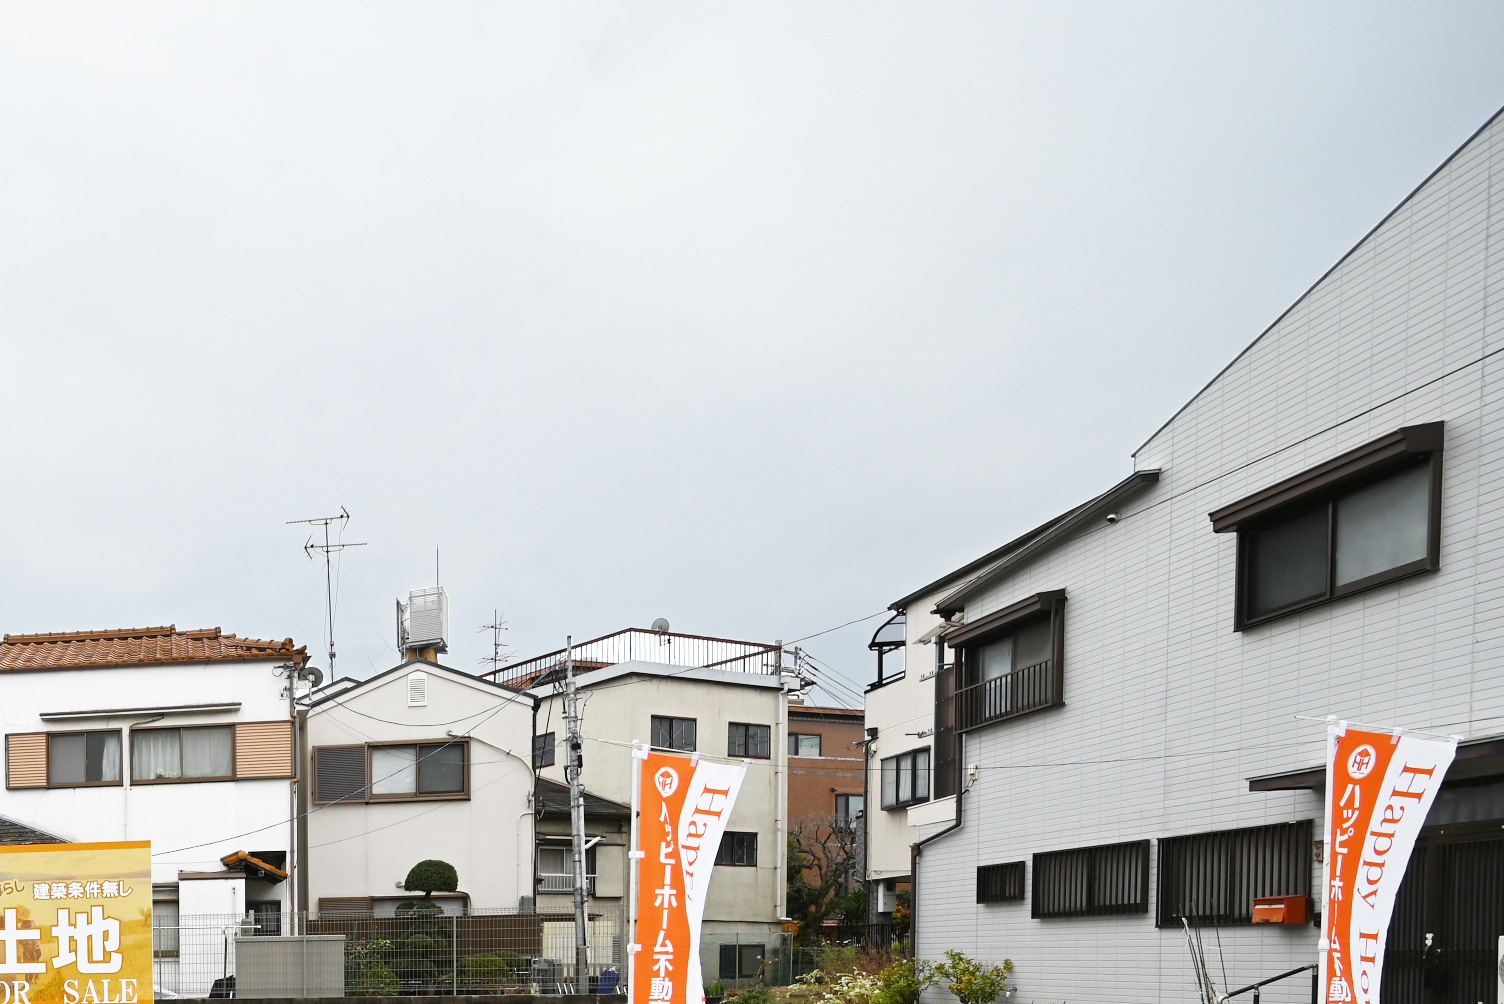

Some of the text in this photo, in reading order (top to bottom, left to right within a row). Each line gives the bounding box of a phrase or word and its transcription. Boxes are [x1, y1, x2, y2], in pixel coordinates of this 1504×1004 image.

[1357, 761, 1437, 910] Happy
[33, 880, 133, 901] 建築条件無し
[63, 978, 138, 1004] SALE
